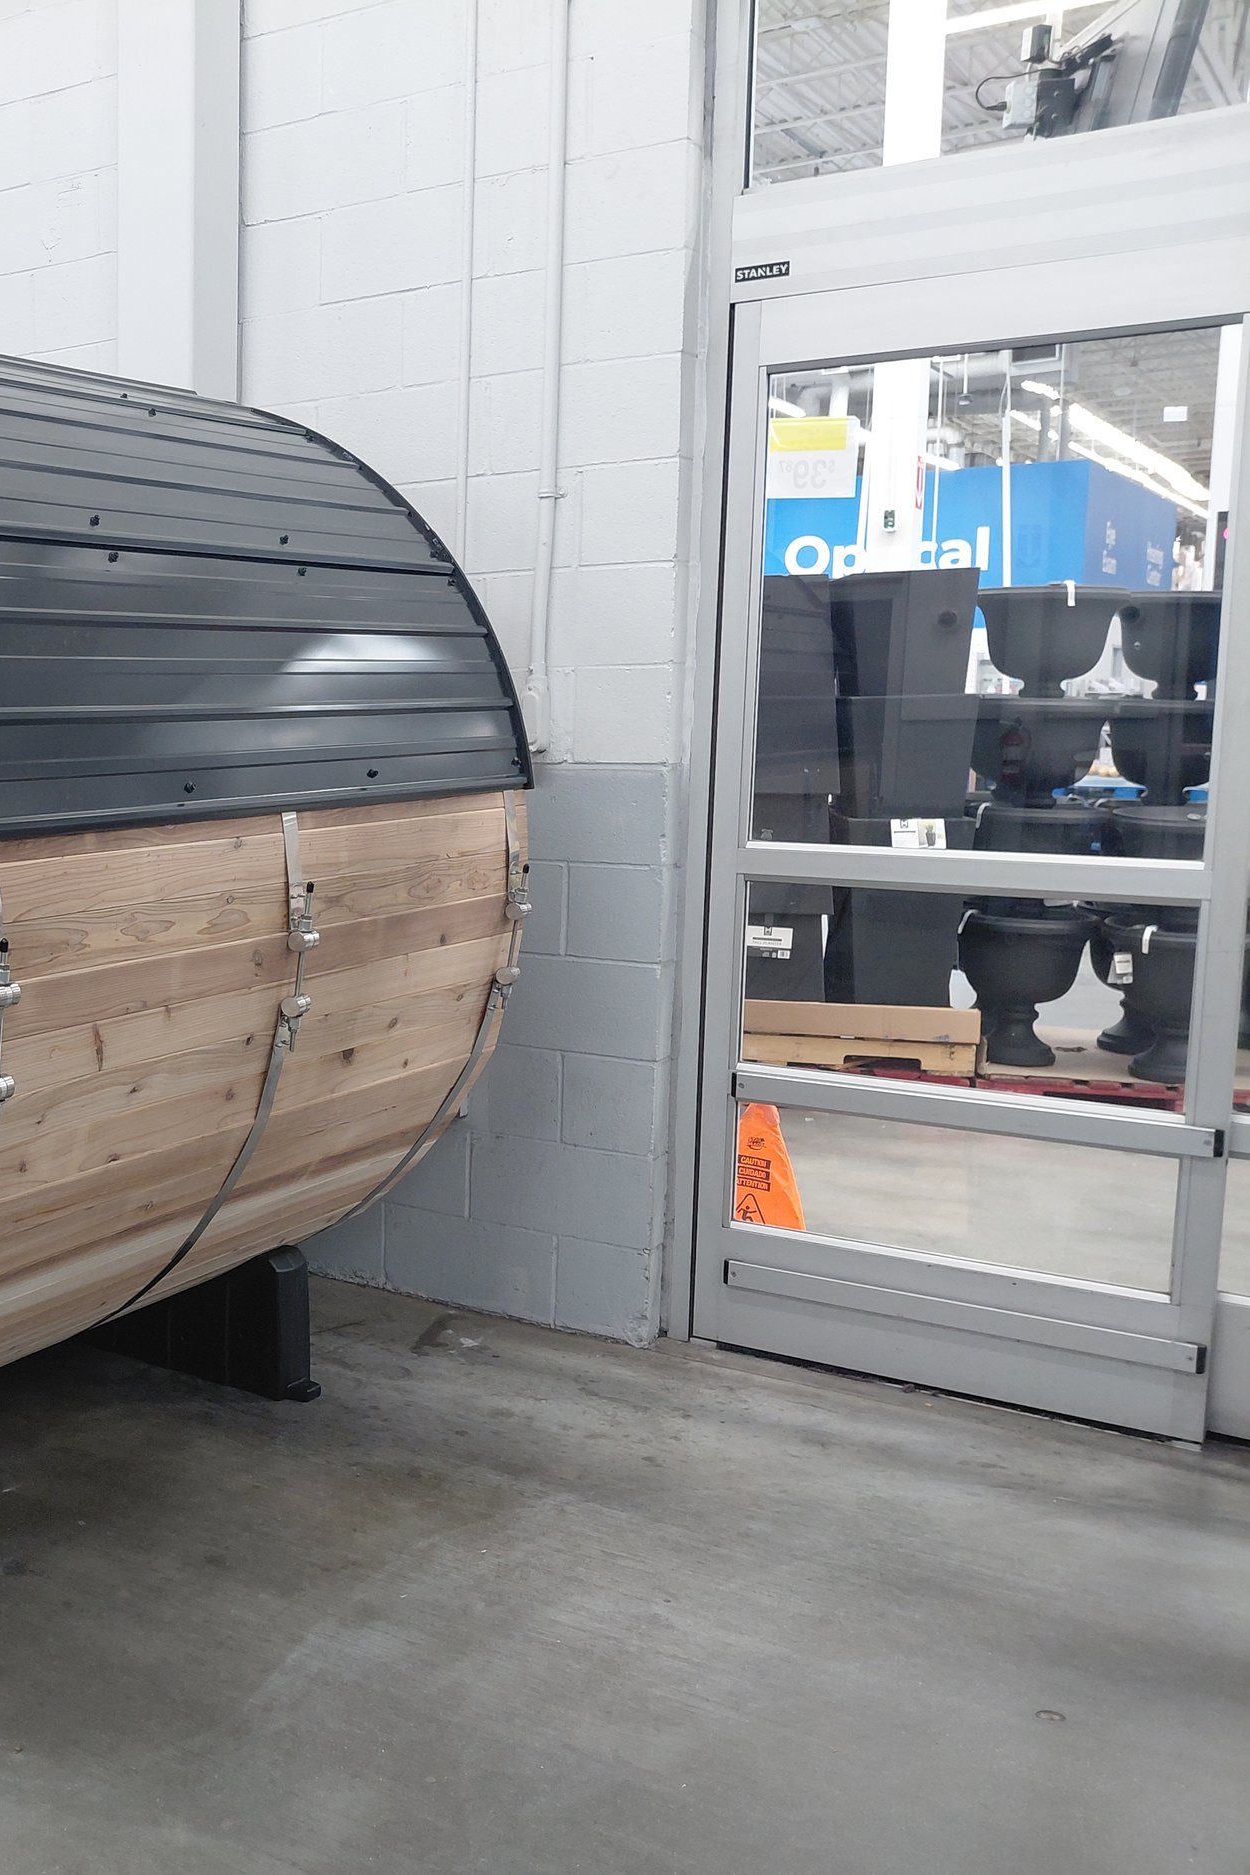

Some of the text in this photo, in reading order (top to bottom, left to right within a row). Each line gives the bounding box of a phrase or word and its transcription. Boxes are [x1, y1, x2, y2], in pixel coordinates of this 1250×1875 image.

[736, 263, 789, 280] STANLEY
[784, 526, 990, 579] Opal
[740, 1156, 767, 1168] CAUTION
[738, 1166, 767, 1179] CUIDADO
